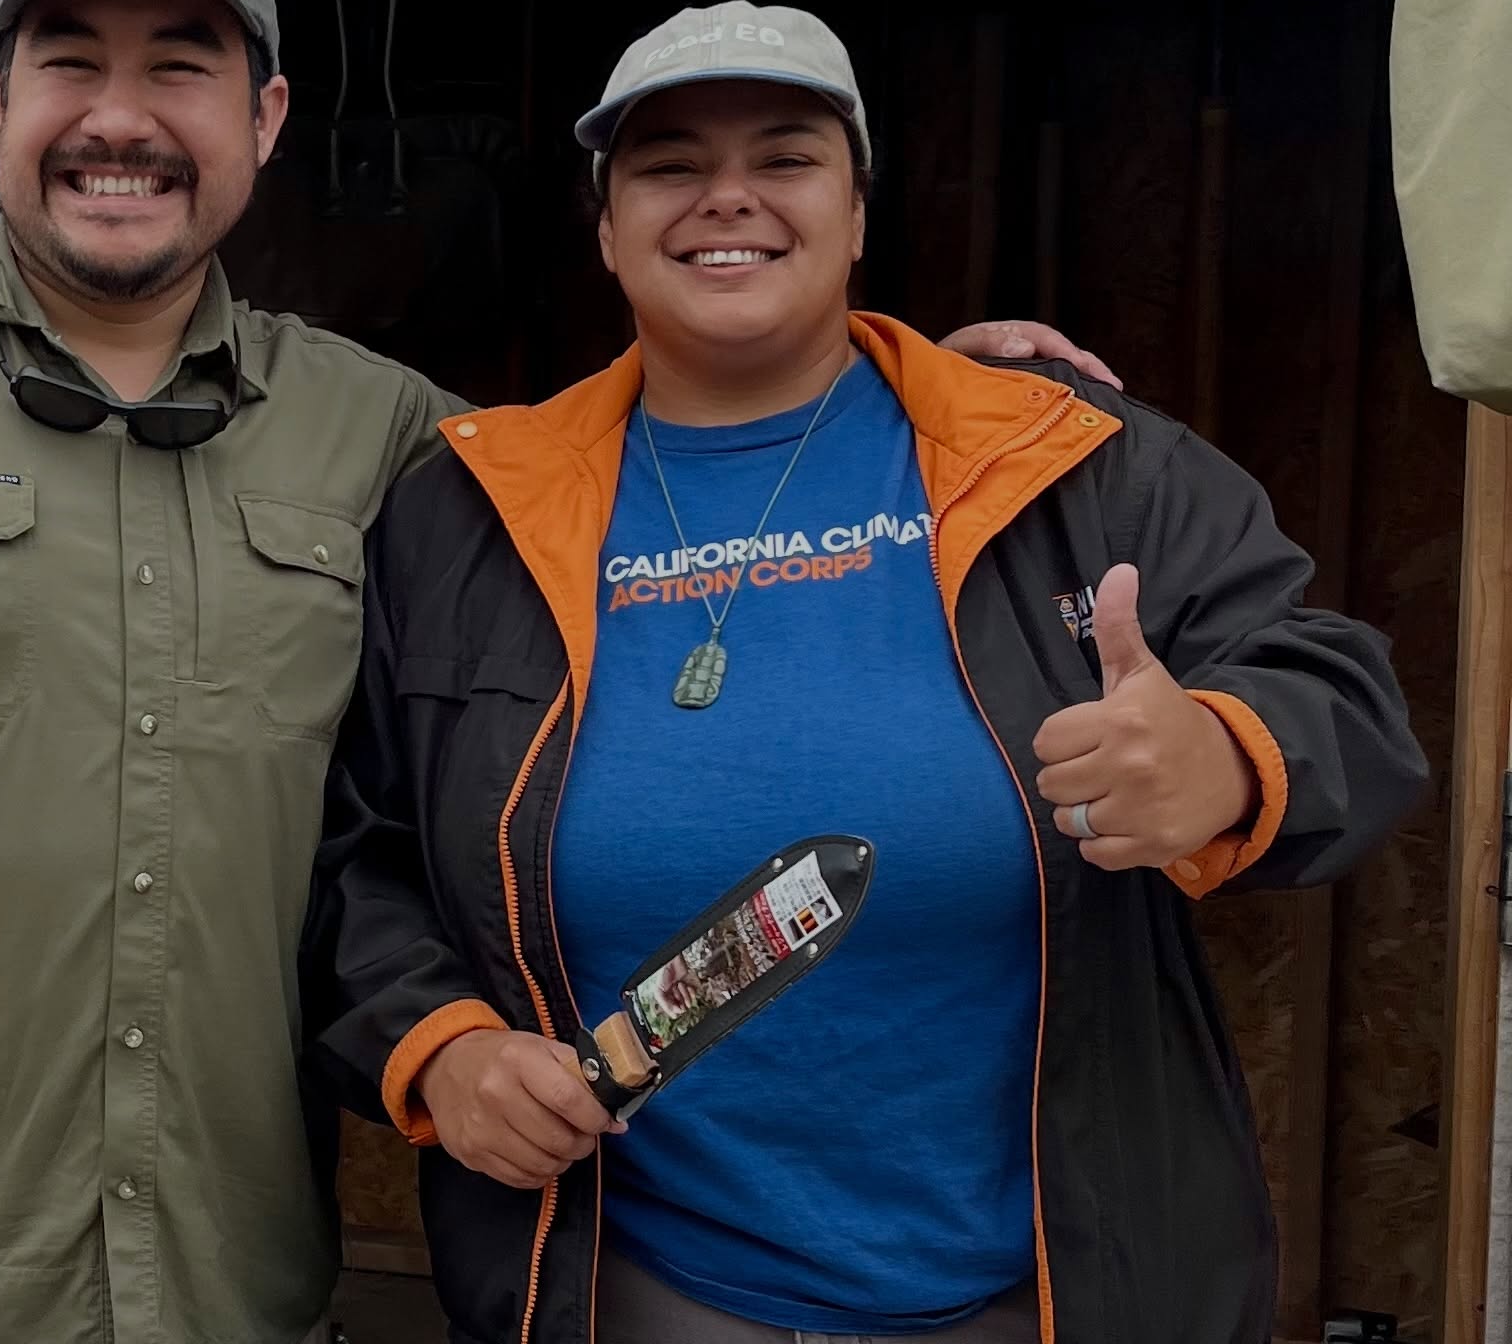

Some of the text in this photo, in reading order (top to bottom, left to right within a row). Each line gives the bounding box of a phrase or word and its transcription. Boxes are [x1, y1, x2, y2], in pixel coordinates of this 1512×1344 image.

[645, 26, 725, 68] Food
[605, 512, 933, 582] CALIFORNIA CLIMAT
[608, 545, 872, 612] ACTION CORPS
